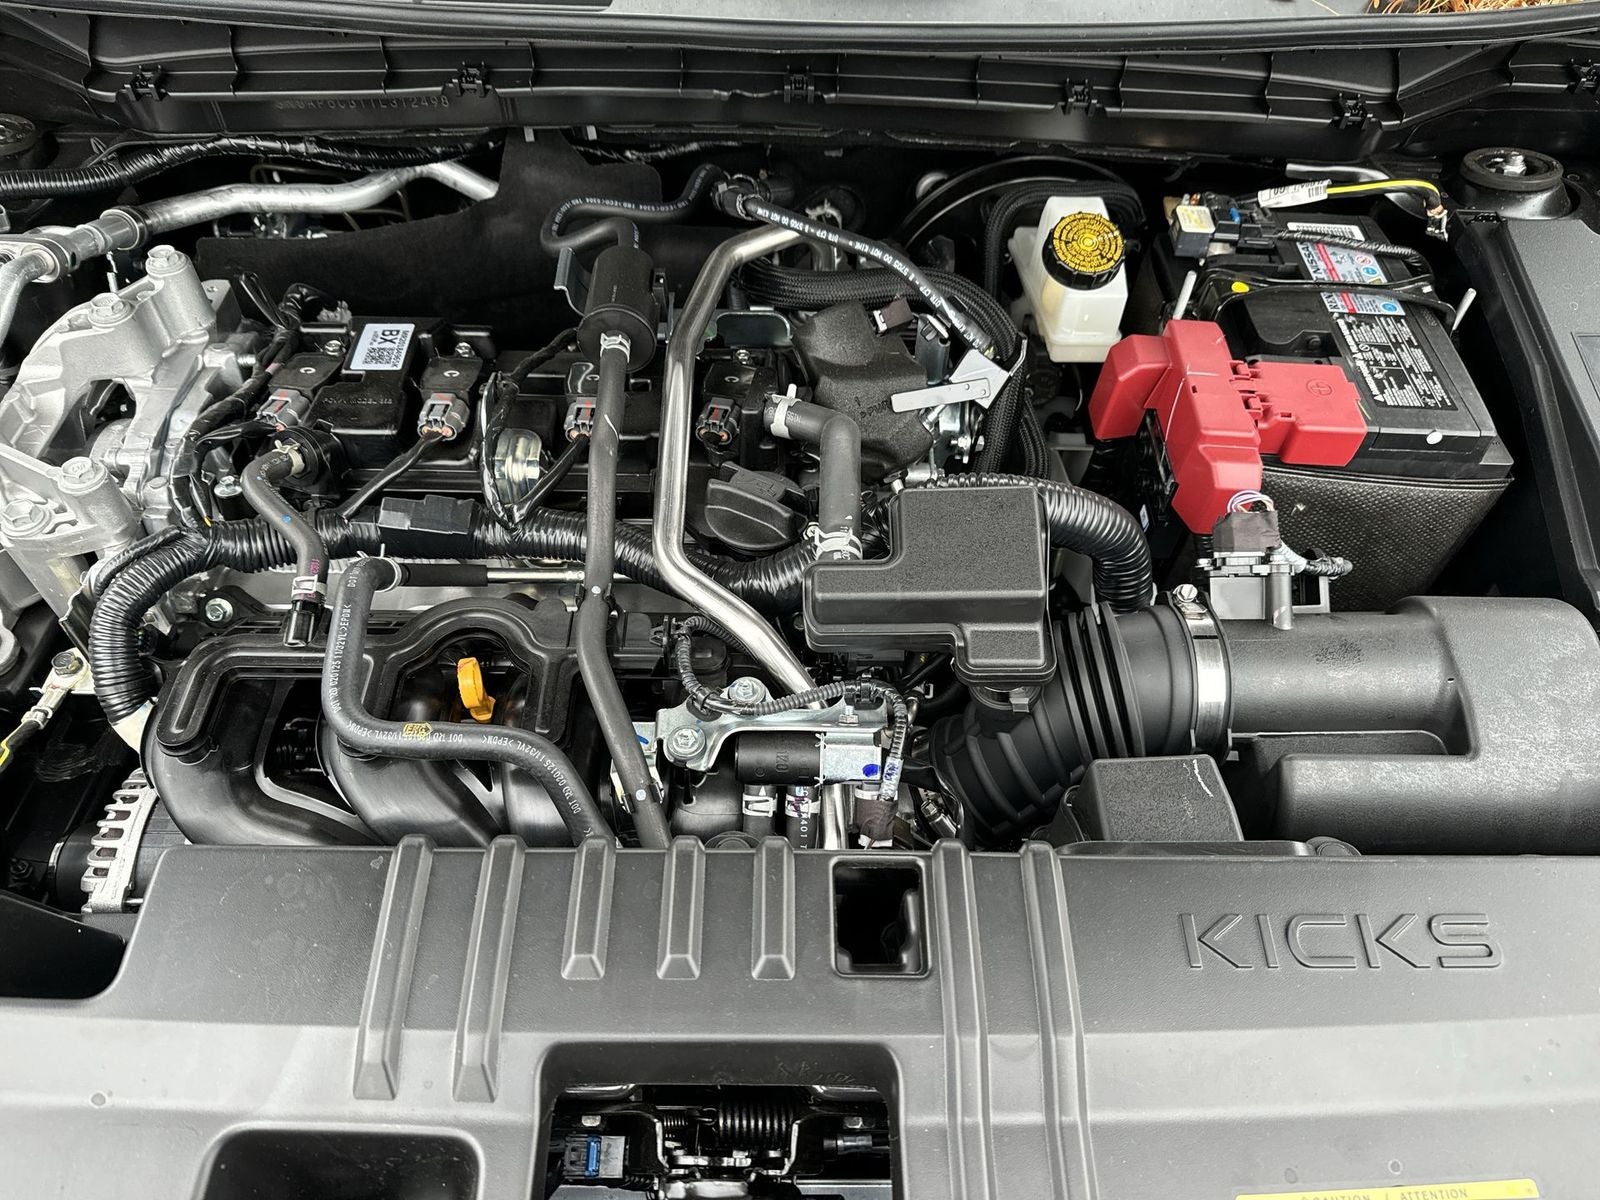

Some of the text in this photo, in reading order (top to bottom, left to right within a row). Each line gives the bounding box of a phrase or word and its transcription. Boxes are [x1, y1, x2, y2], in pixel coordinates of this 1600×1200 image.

[770, 212, 780, 224] NOT
[854, 240, 869, 254] KINK
[869, 247, 883, 259] NOT
[883, 254, 893, 264] DO
[892, 259, 910, 276] 5705
[919, 284, 932, 296] CFP
[377, 329, 401, 345] BX
[333, 632, 347, 659] 11/32VL
[330, 660, 342, 686] 020125
[330, 700, 342, 714] DOT
[450, 733, 463, 742] DOT
[482, 734, 514, 747] >EPDM<
[516, 740, 546, 762] 11/32VL
[544, 759, 567, 786] 020125
[568, 800, 582, 814] DOT
[1178, 912, 1504, 971] KICKS
[1400, 1188, 1468, 1200] ATTENTION
